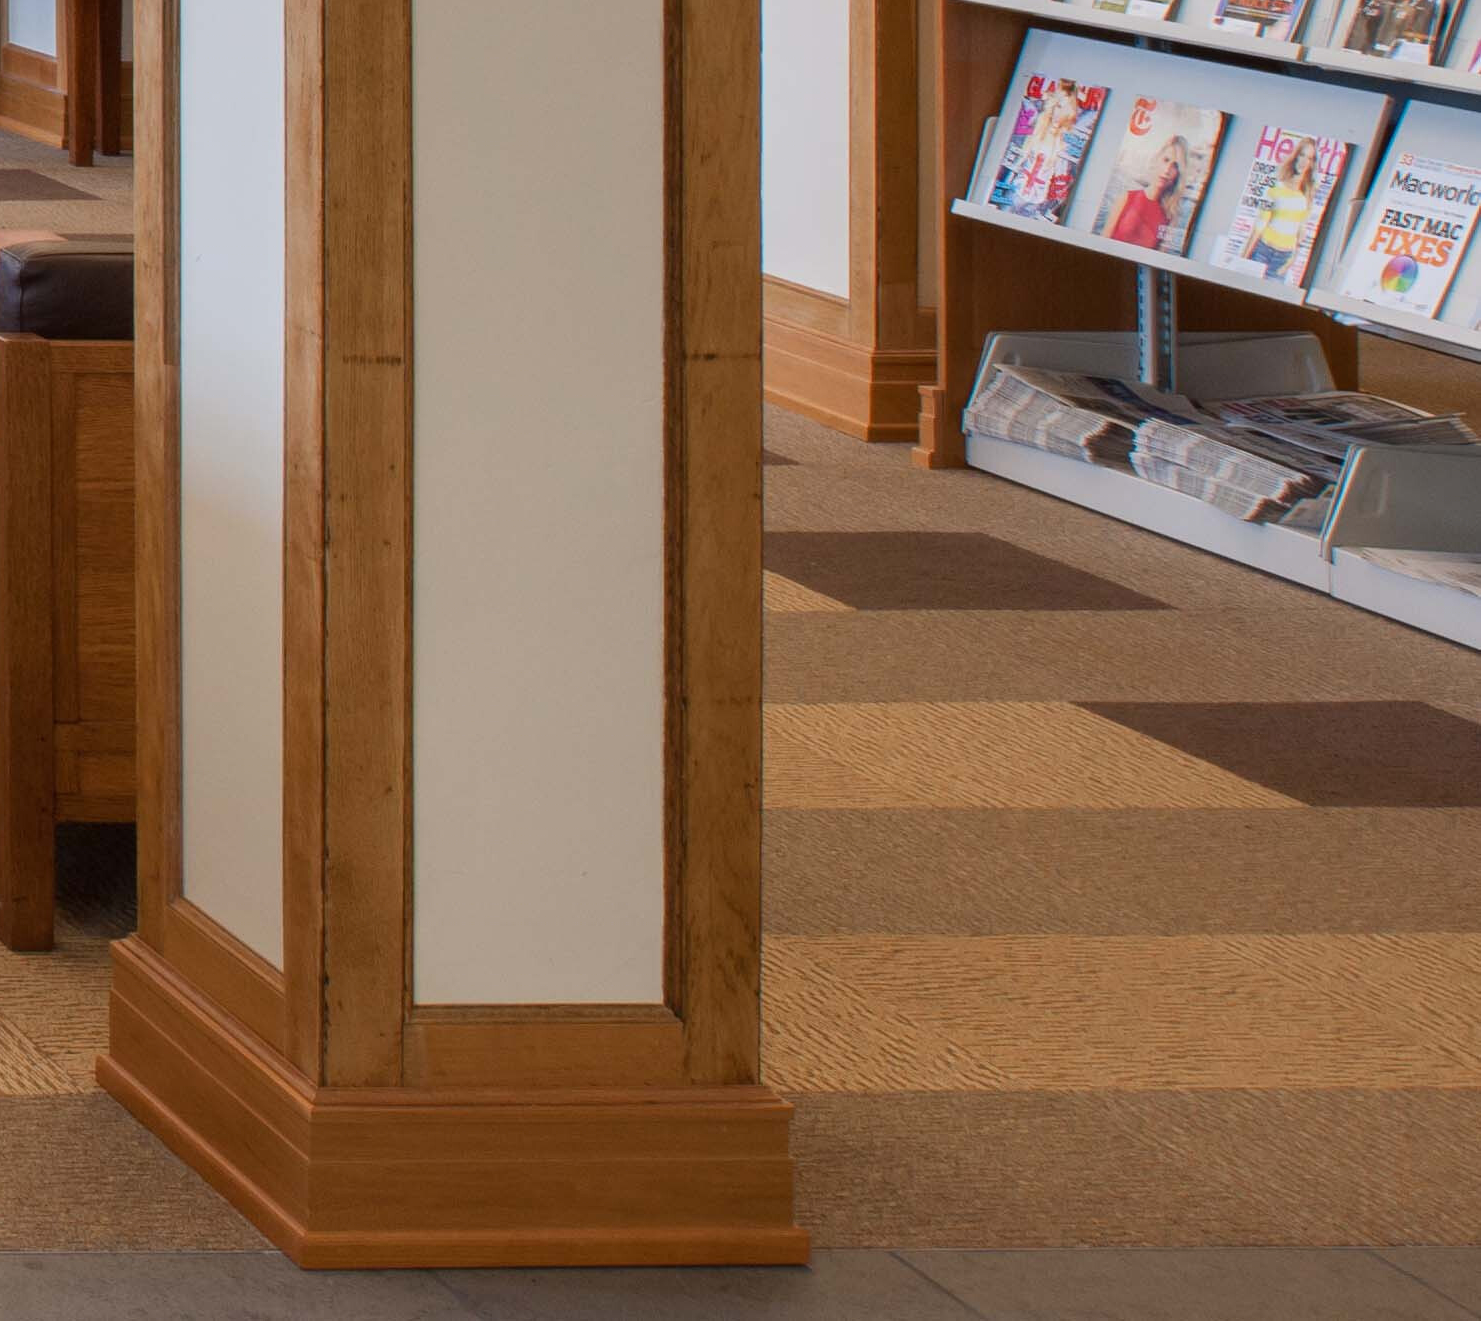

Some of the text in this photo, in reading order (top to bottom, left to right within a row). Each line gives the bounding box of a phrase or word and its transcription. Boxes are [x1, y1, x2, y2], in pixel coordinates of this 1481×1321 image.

[1381, 208, 1463, 241] FAST MAC
[1369, 226, 1455, 268] FIXES
